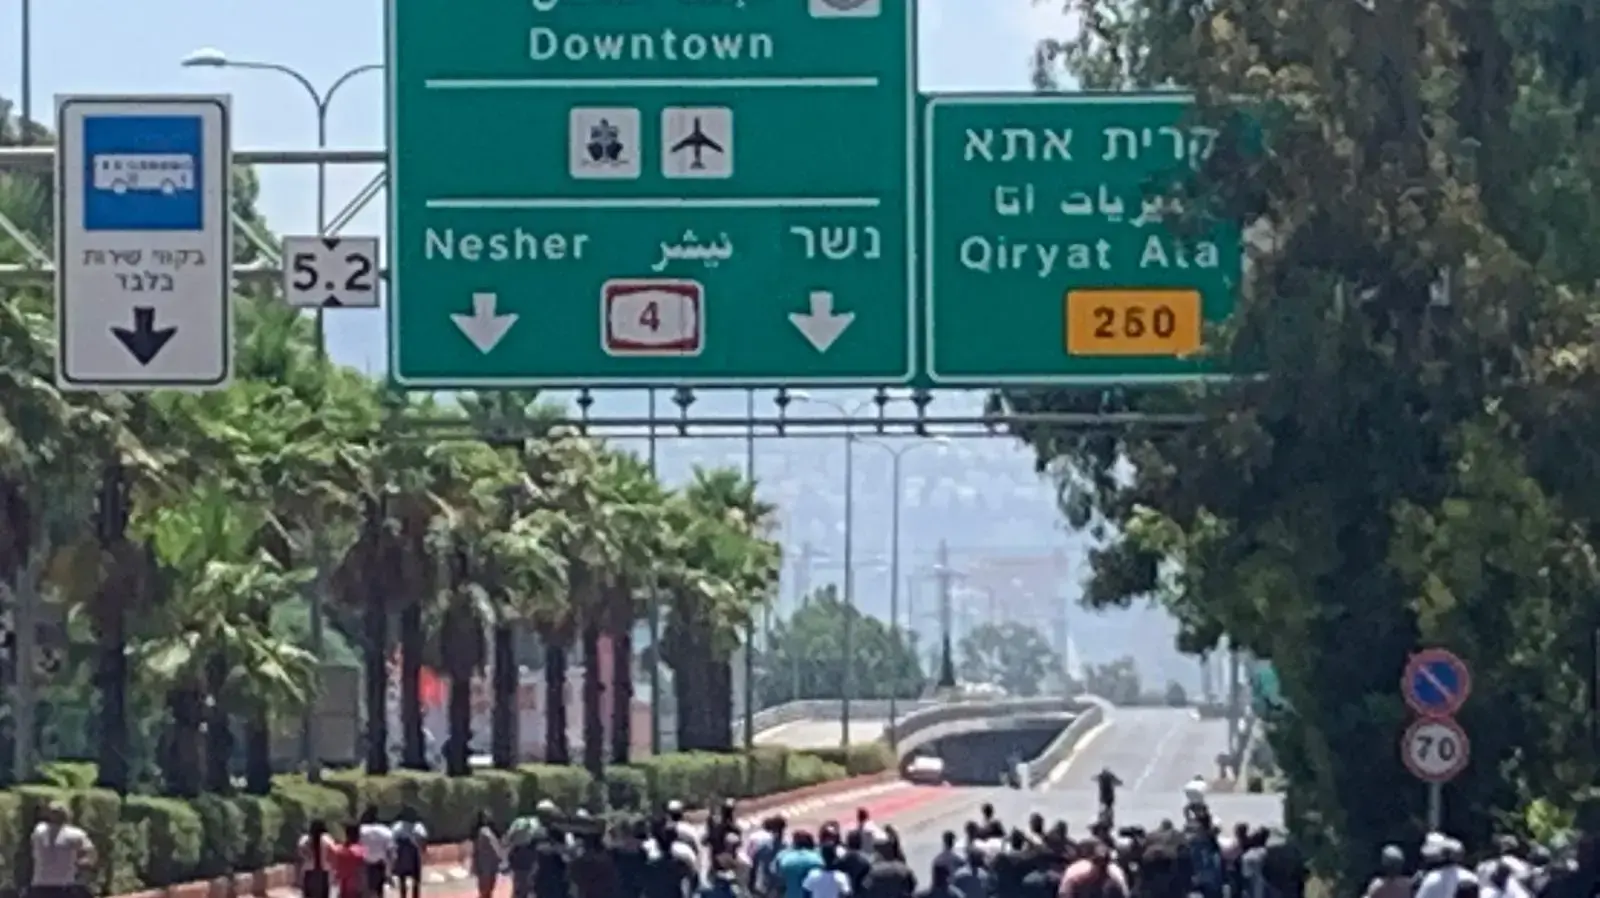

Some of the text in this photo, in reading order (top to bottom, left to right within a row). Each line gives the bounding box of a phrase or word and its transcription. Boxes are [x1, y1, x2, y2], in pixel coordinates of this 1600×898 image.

[529, 27, 775, 61] Downtown
[963, 125, 1220, 173] קרית אתא
[424, 227, 590, 260] Nesher
[650, 229, 734, 272] نيشر
[789, 225, 882, 260] נשר
[959, 234, 1220, 278] Qiryat Ata
[113, 269, 175, 292] בלבד
[292, 253, 372, 292] 5.2
[639, 301, 661, 333] 4
[1416, 735, 1457, 762] 70
